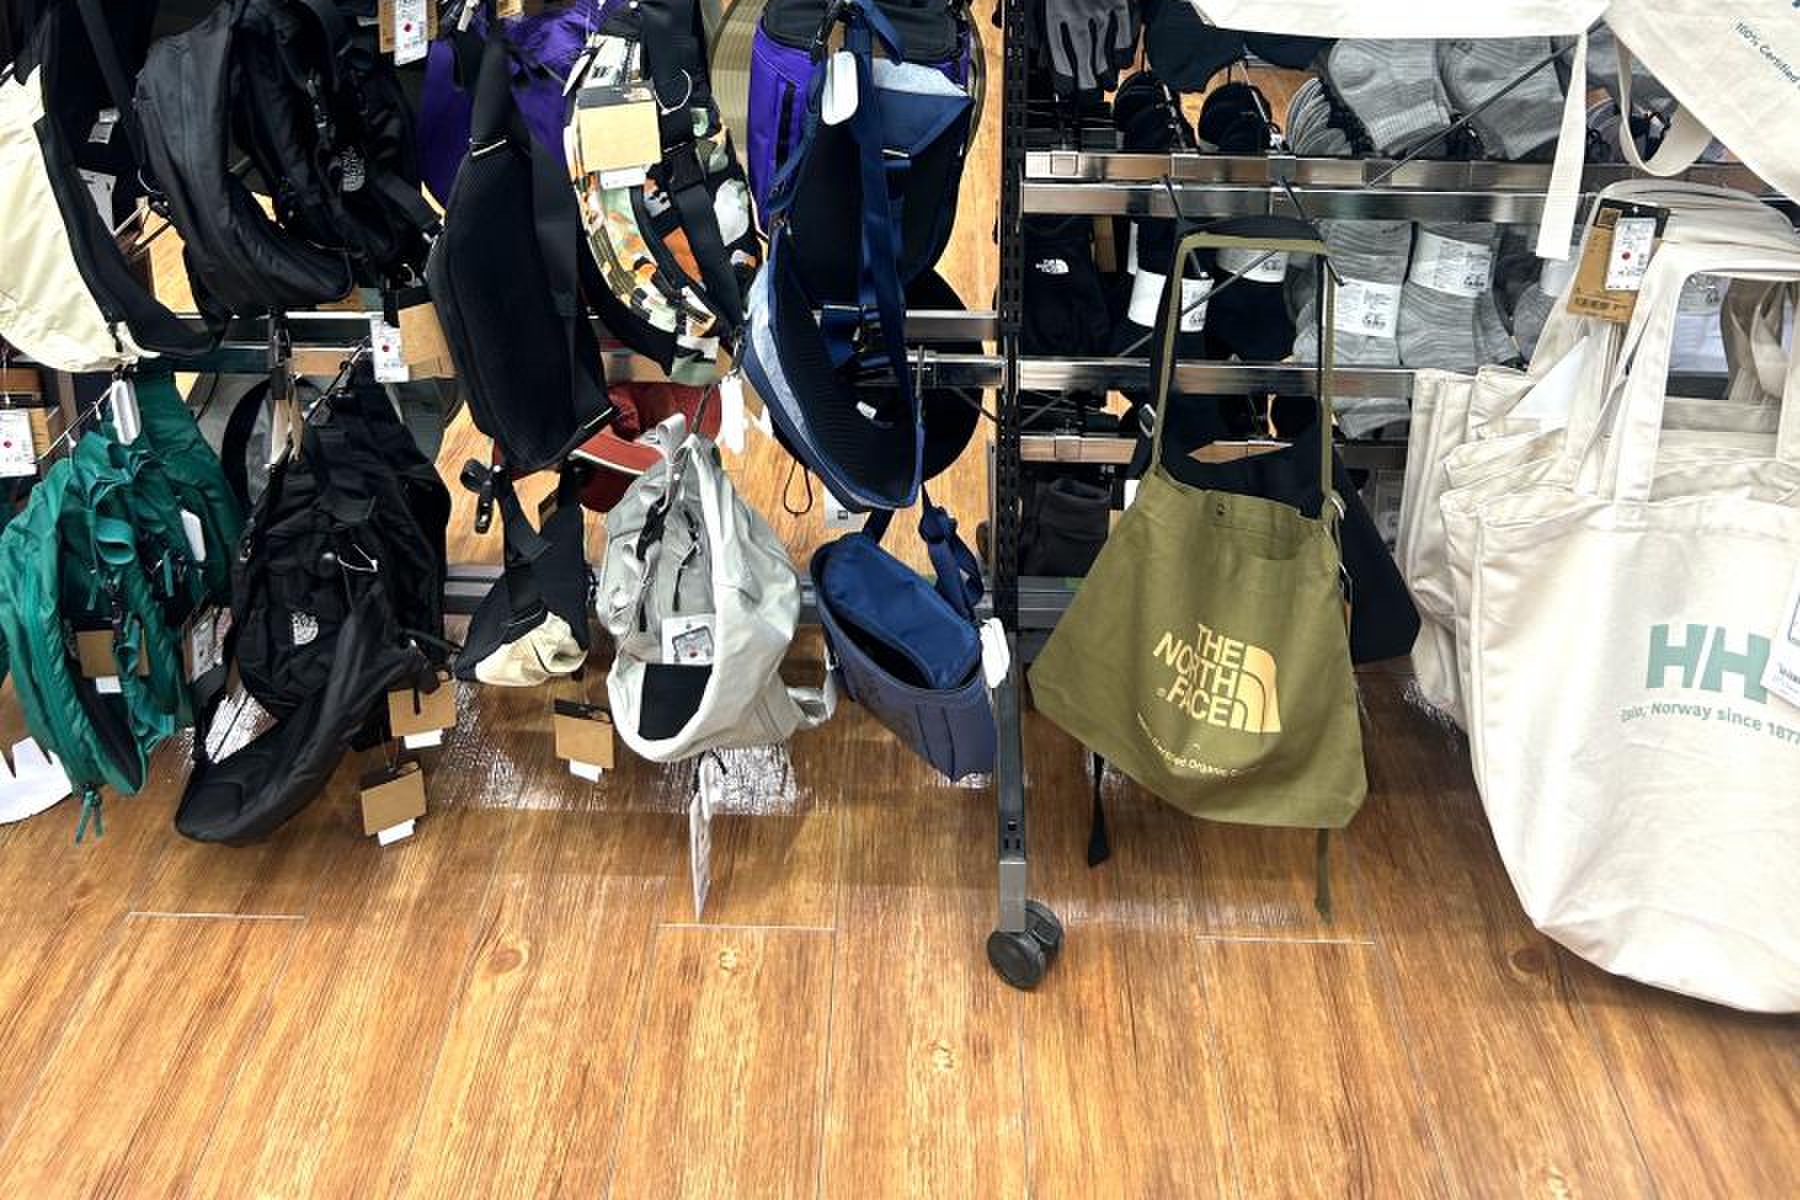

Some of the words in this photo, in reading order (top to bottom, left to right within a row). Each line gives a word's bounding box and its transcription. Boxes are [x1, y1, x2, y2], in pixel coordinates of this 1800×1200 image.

[1153, 631, 1237, 699] NORTH
[1198, 623, 1245, 669] THE
[1166, 675, 1232, 727] FACE
[1650, 701, 1713, 721] Norway
[1716, 707, 1762, 732] since
